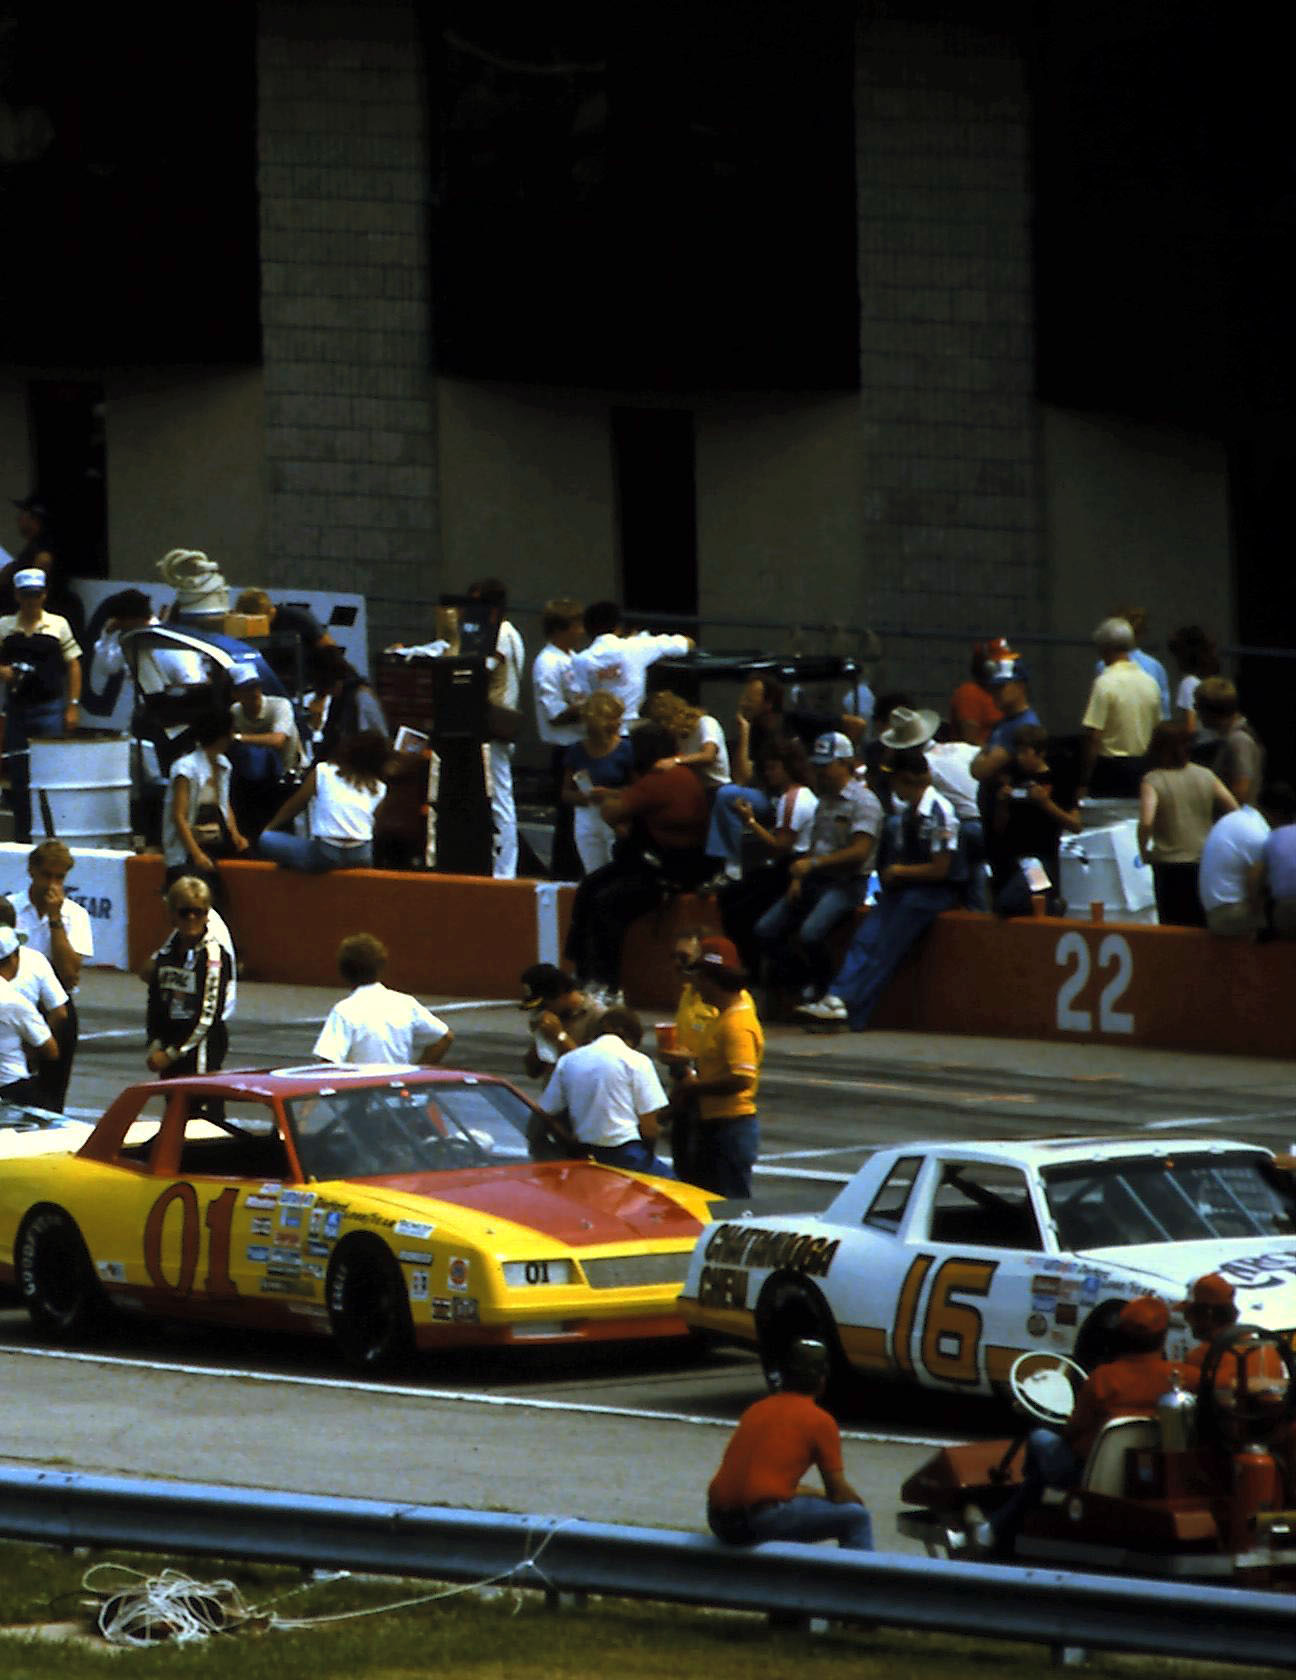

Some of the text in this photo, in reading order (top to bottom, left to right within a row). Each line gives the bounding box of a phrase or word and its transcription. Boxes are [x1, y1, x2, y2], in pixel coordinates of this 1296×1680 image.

[1055, 930, 1135, 1034] 22
[144, 1181, 241, 1298] 01
[525, 1262, 550, 1285] 01
[892, 1252, 1001, 1385] 16
